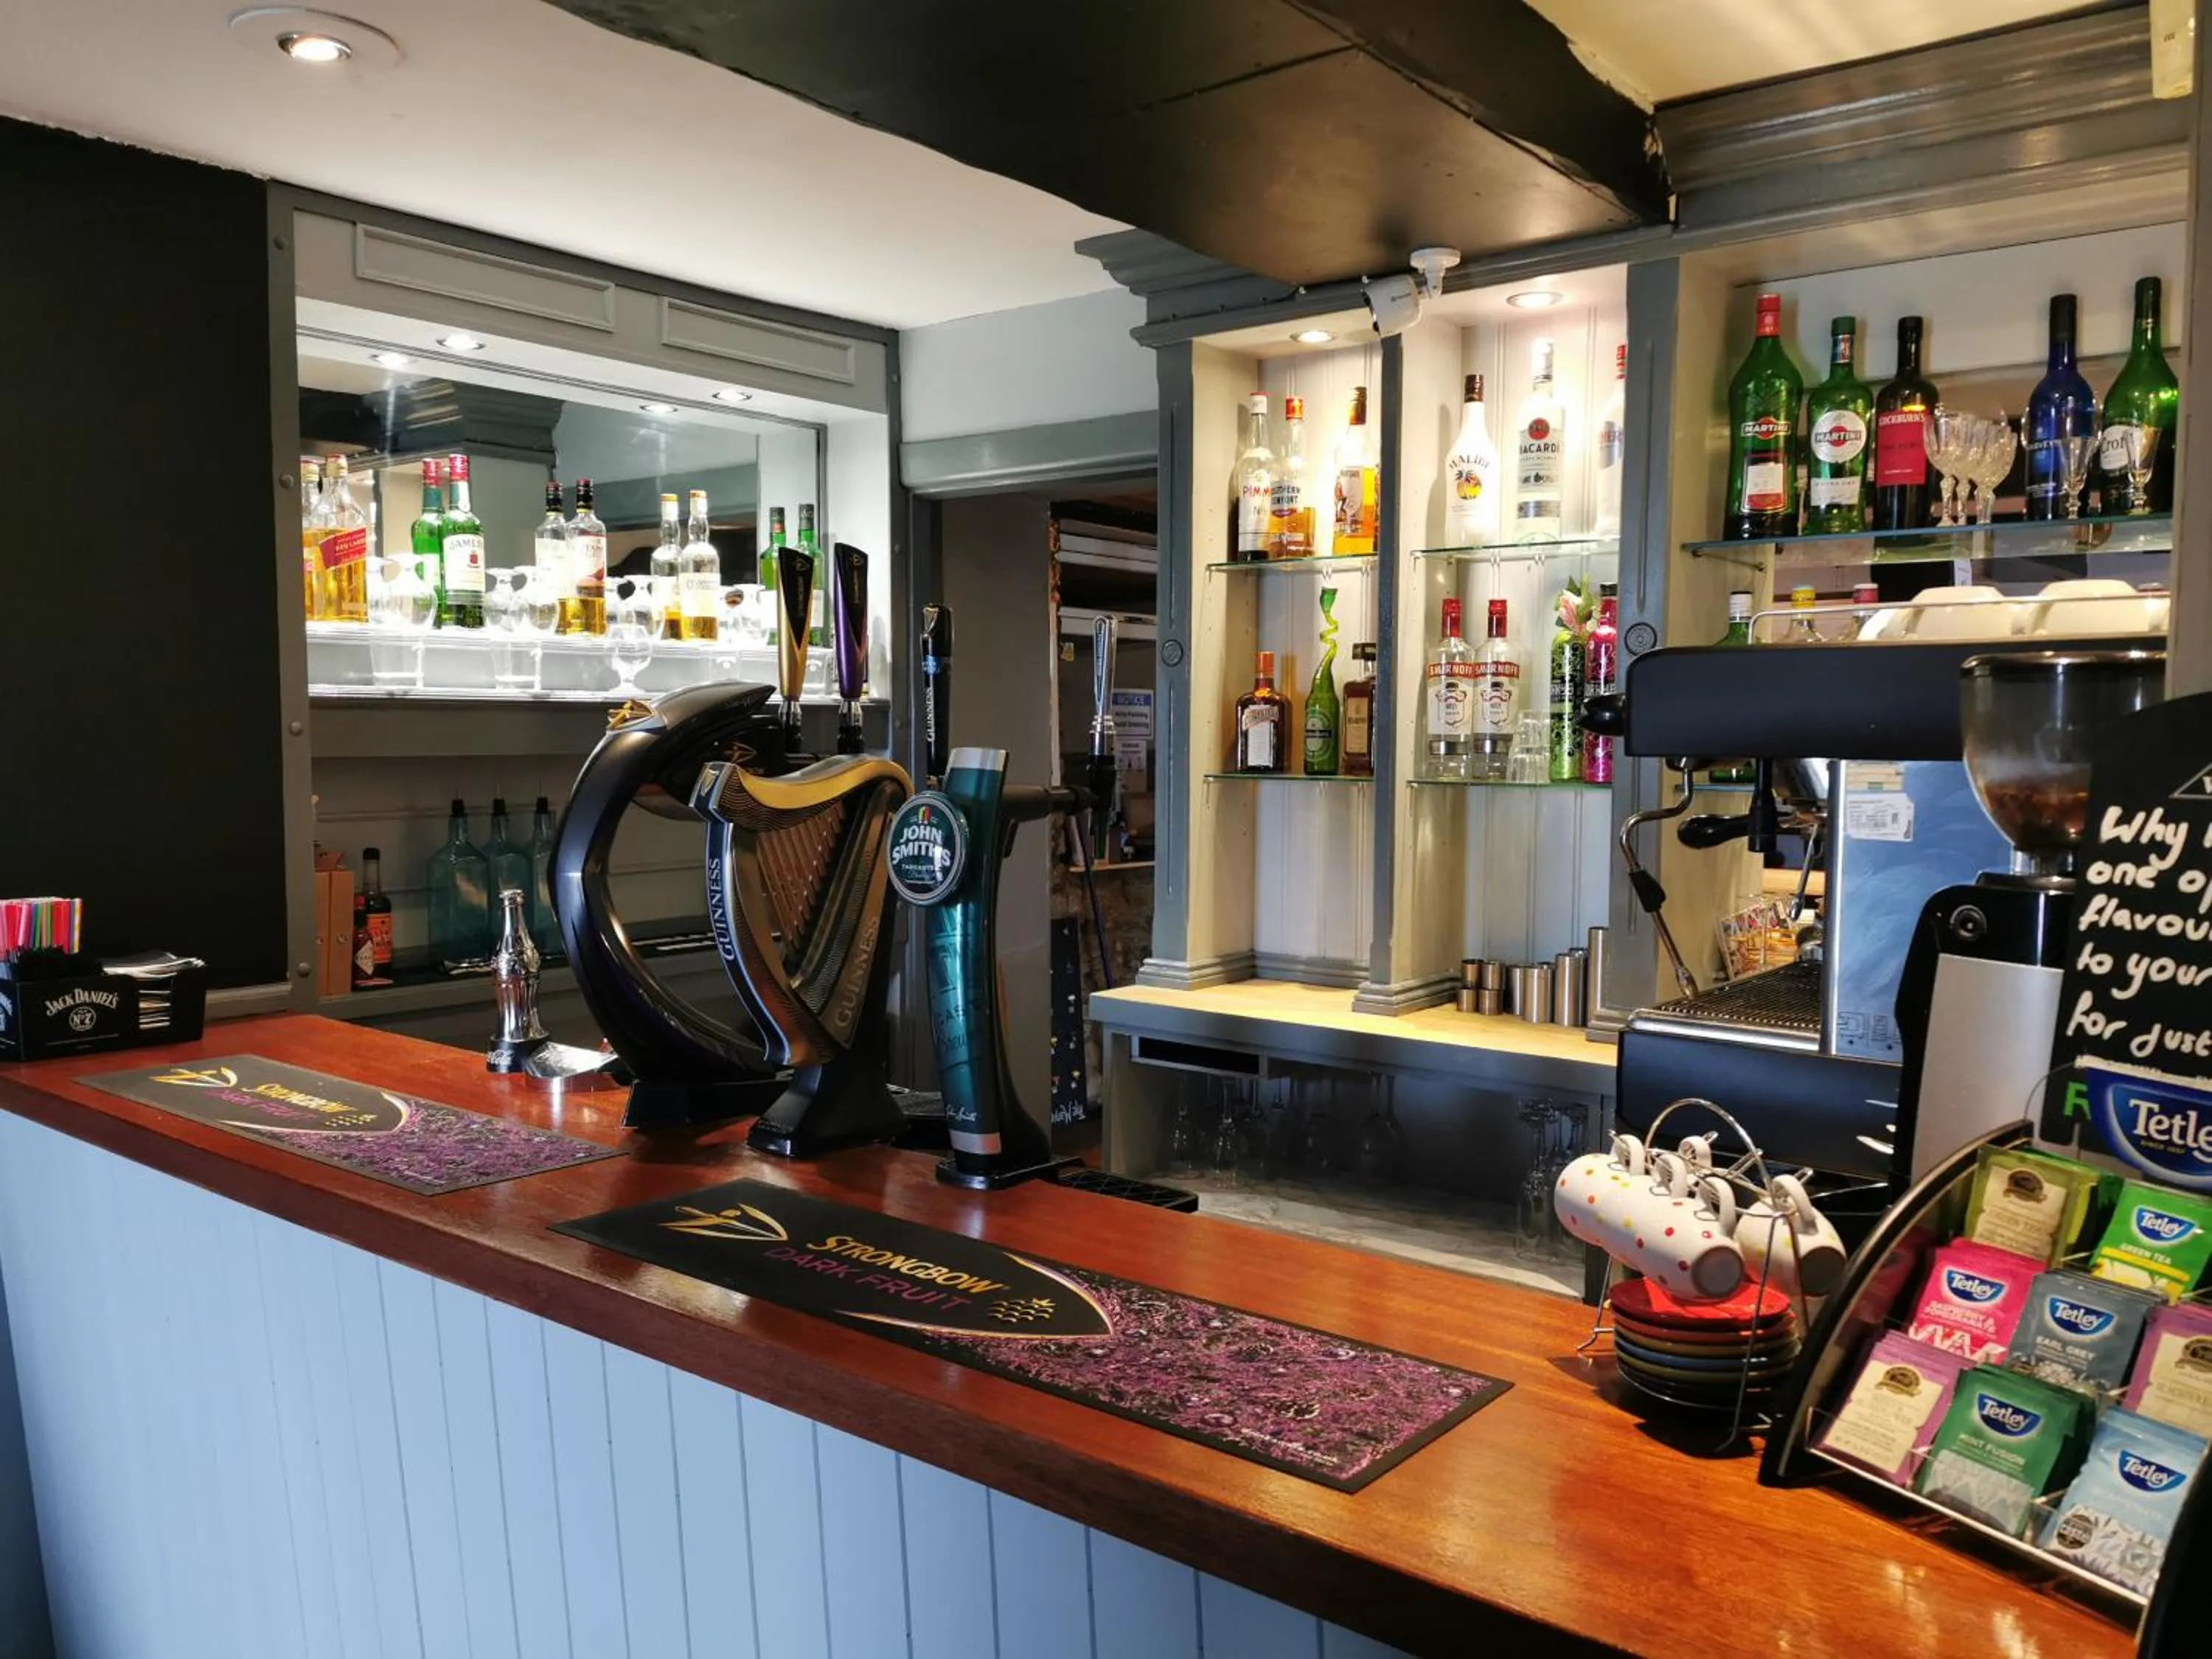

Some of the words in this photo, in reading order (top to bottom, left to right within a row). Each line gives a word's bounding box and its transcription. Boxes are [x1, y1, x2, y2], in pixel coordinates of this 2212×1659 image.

[1744, 425, 1789, 433] MARTINI
[1815, 429, 1862, 442] MARTINI
[1429, 663, 1472, 677] SMIRNOFF
[1475, 661, 1519, 676] SMIRNOFF
[899, 824, 942, 846] JOHN
[2099, 805, 2189, 871] Why
[2085, 860, 2160, 889] one
[707, 857, 737, 961] GUINNESS
[2077, 893, 2212, 942] flavou
[834, 914, 878, 1028] GUINNESS
[2076, 941, 2115, 975] to
[2110, 952, 2212, 1001] your
[44, 994, 74, 1017] JACK
[74, 987, 120, 1010] DANIEL'S
[2065, 990, 2129, 1041] for
[2140, 1211, 2184, 1238] Tetley
[762, 1247, 863, 1279] DARK
[855, 1274, 973, 1310] FRUIT
[806, 1235, 1003, 1293] STRONGBOW
[1950, 1273, 1997, 1300] Tetley
[2054, 1303, 2104, 1331] Tetley
[2035, 1335, 2063, 1349] EARL
[2065, 1345, 2096, 1360] GREY
[1981, 1397, 2030, 1431] Tetley
[2123, 1456, 2177, 1489] Tetley
